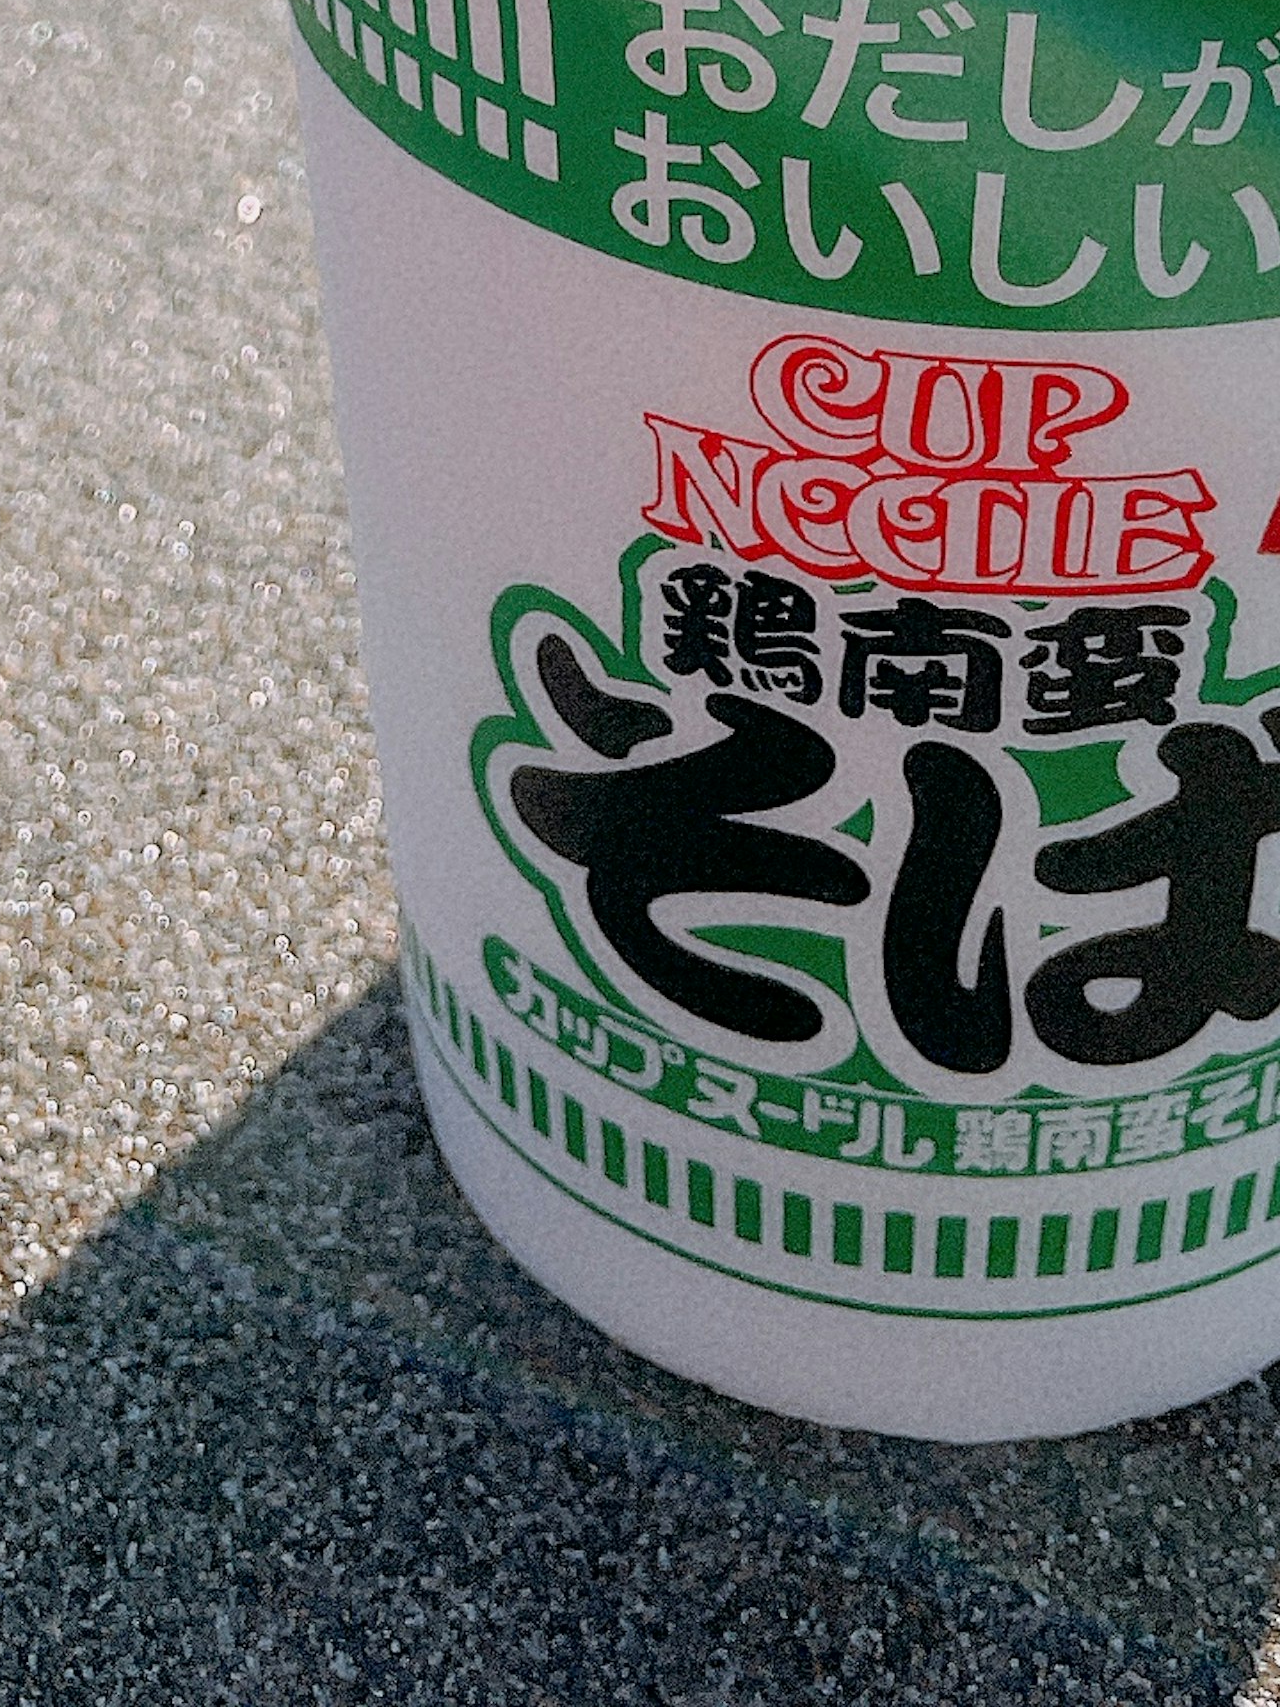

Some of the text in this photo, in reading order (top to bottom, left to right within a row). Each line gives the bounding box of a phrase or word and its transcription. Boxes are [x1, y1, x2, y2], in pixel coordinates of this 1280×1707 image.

[748, 333, 1129, 475] CUP
[641, 412, 1219, 595] NOODLE
[661, 561, 1193, 736] 鶏南蛮
